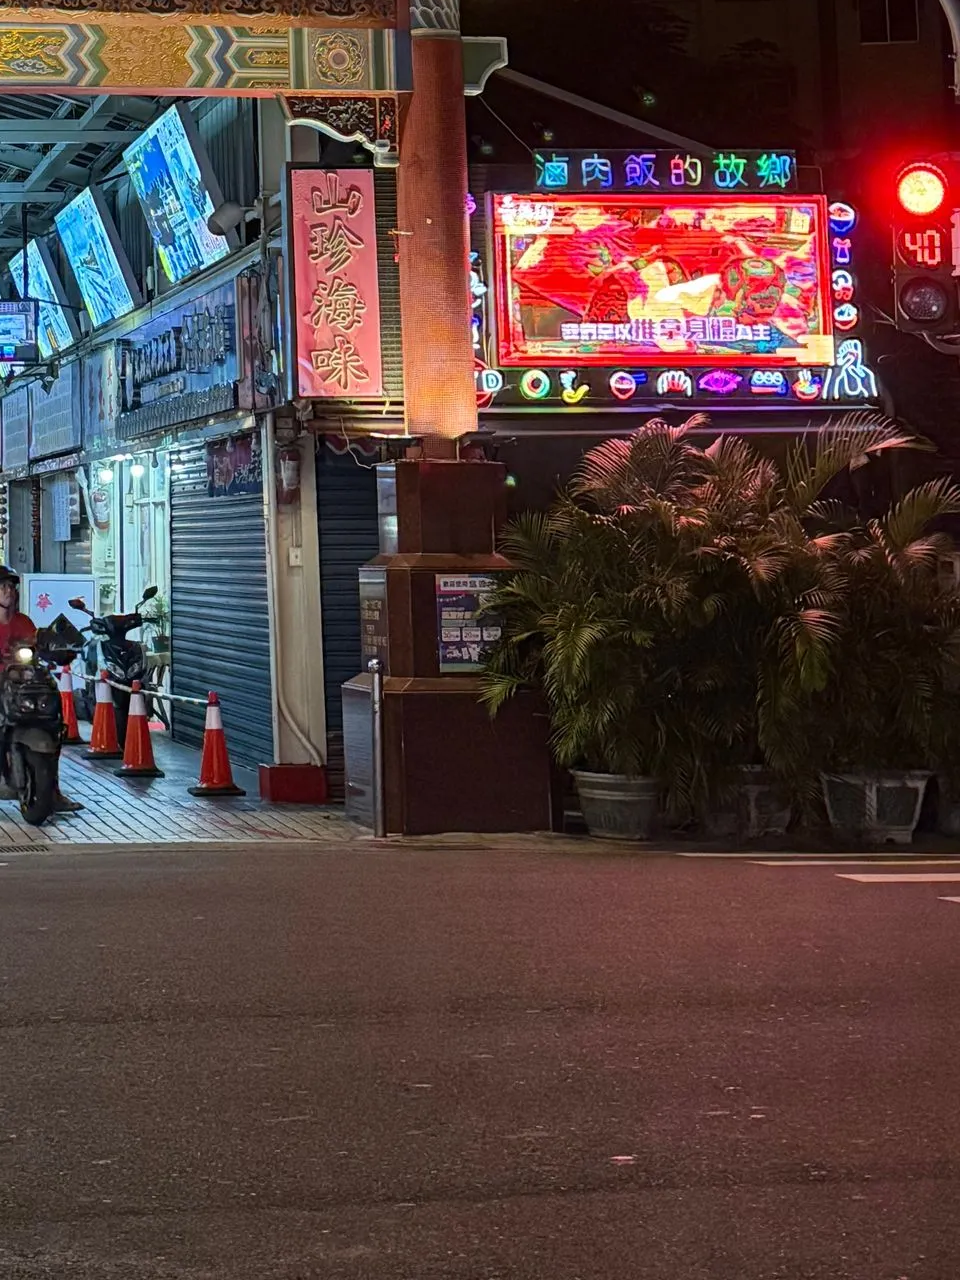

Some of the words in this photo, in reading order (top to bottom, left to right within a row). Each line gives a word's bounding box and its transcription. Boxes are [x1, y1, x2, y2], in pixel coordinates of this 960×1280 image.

[535, 153, 792, 188] 滷肉飯的故鄉
[904, 230, 941, 266] 40
[308, 172, 370, 391] 山珍海味
